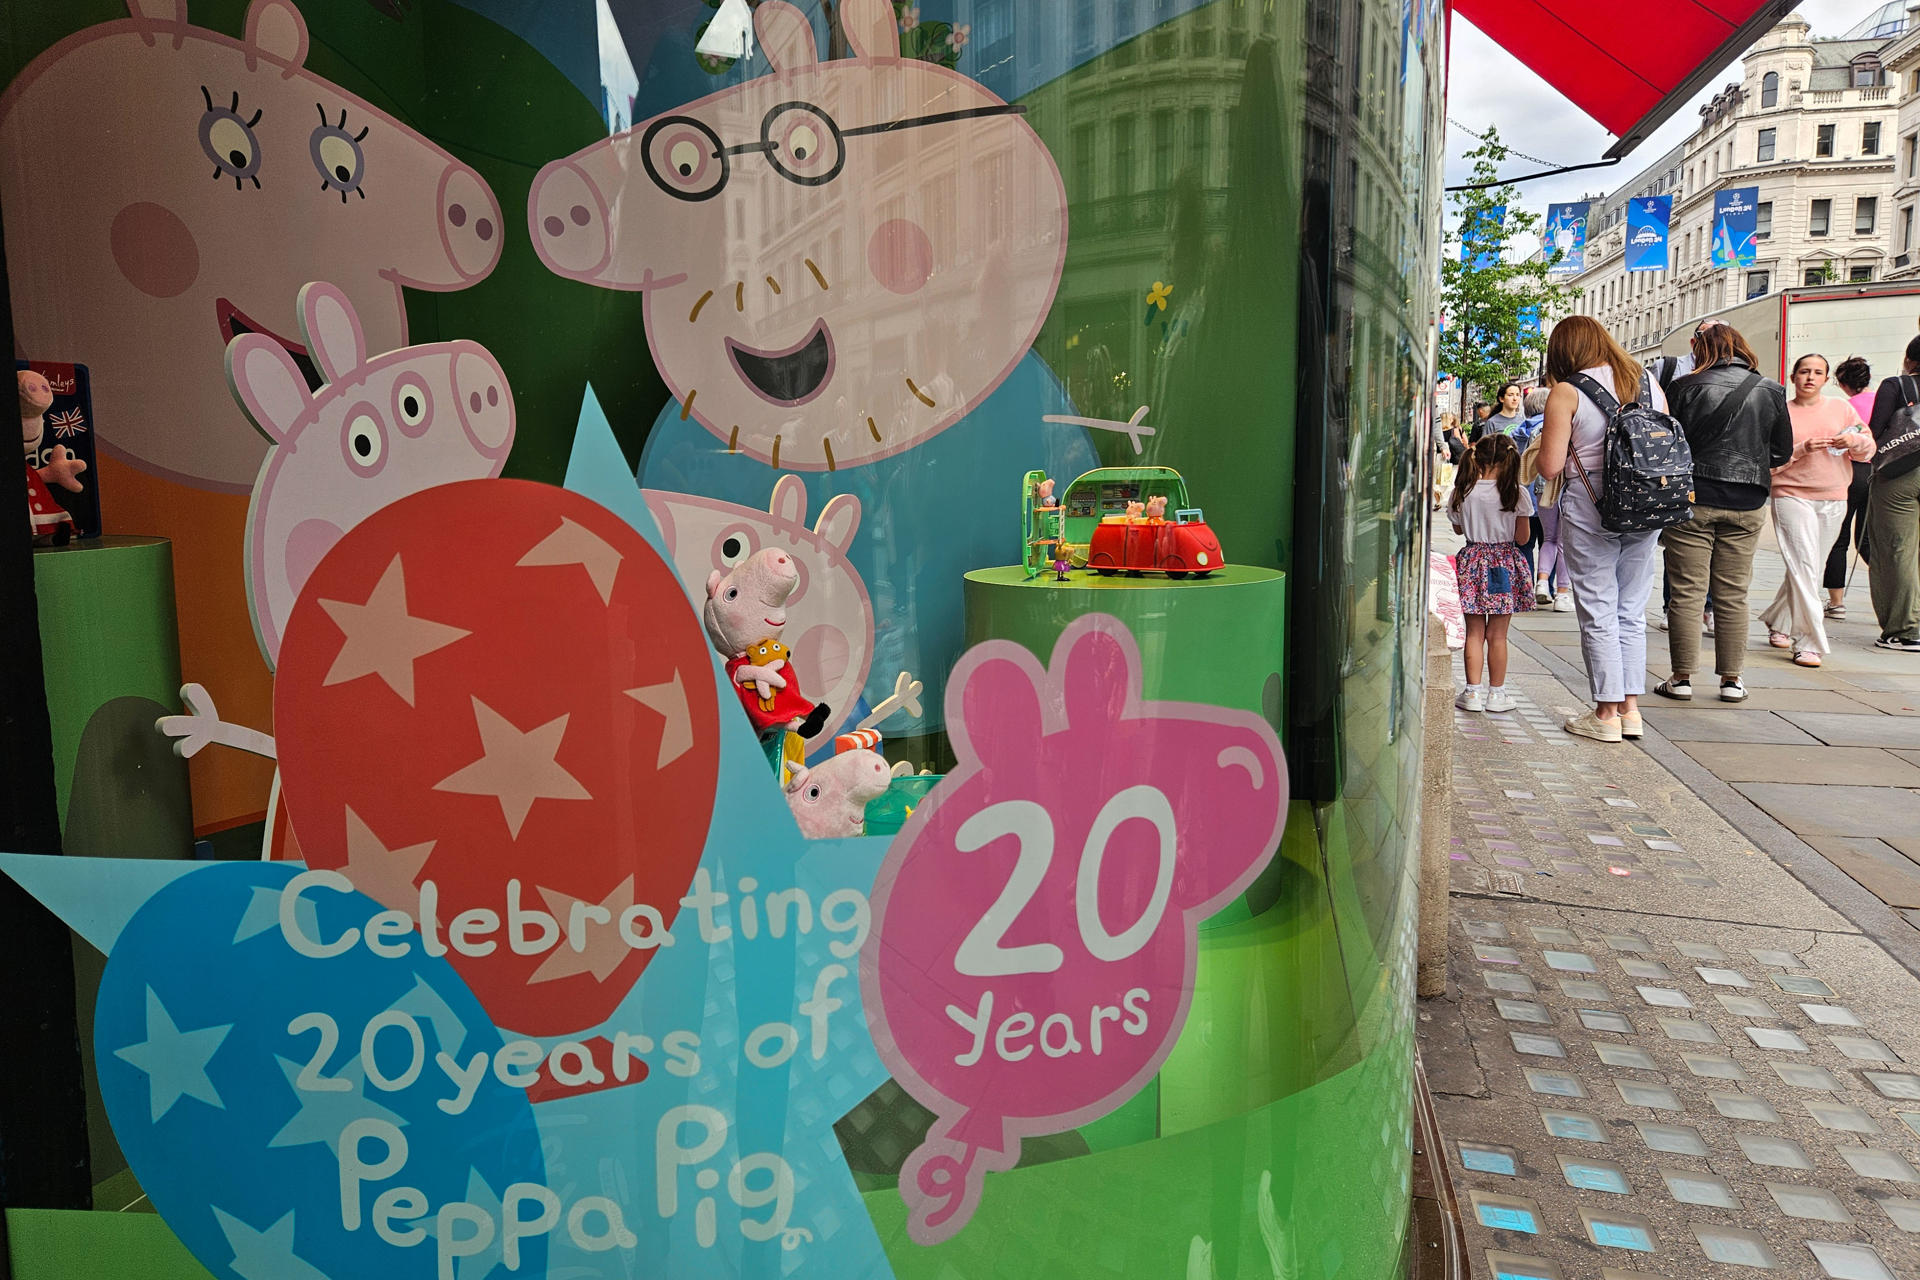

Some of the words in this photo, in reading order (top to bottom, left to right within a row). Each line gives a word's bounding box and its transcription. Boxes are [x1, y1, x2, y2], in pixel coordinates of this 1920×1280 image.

[42, 370, 75, 393] mleys
[1878, 428, 1920, 454] VALENTIN
[278, 867, 872, 959] Celebrating
[954, 784, 1177, 977] 20
[744, 964, 849, 1069] of
[945, 987, 1151, 1067] years
[337, 1117, 639, 1280] Peppa
[656, 1104, 806, 1250] Pig
